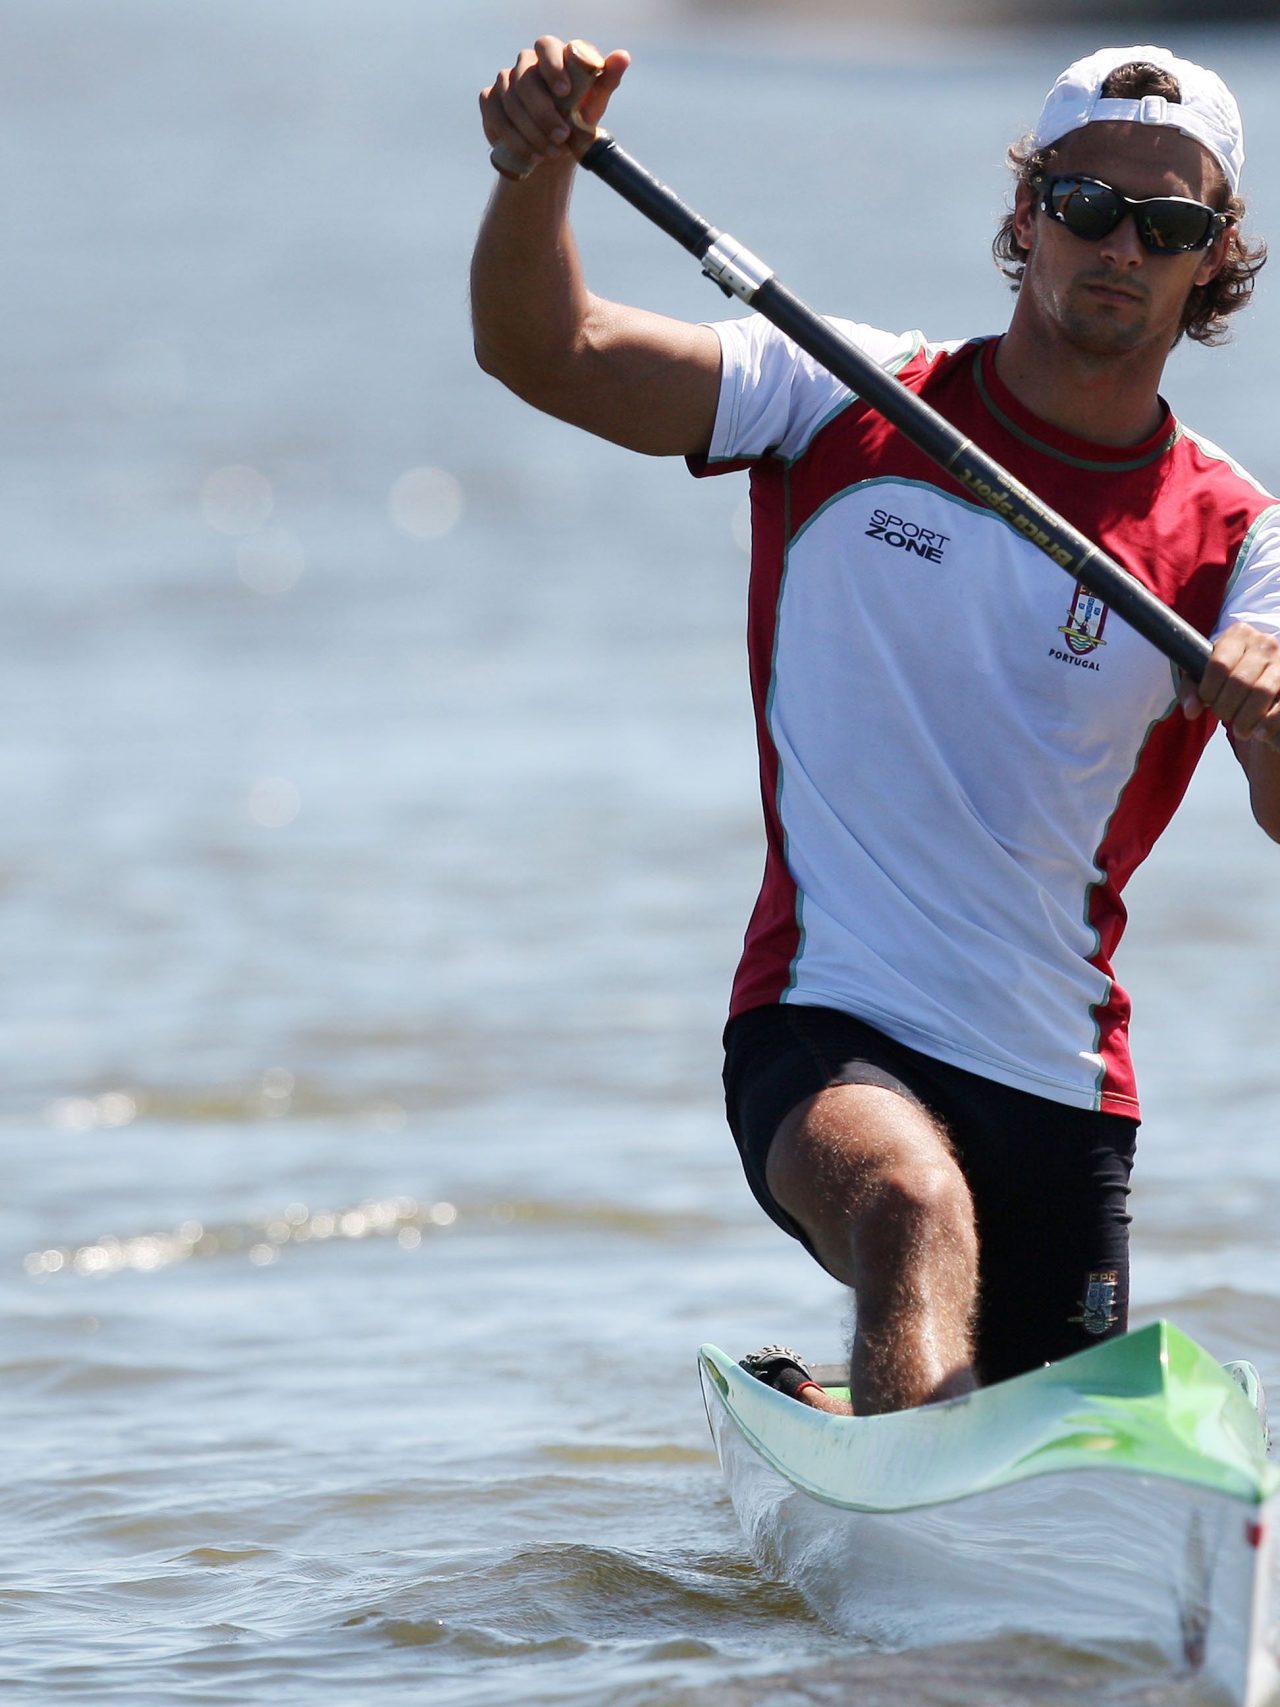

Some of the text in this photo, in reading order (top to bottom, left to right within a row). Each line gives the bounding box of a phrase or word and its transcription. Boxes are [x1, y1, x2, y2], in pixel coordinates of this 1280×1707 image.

[870, 509, 951, 549] SPORT
[959, 468, 1074, 567] Braca-sport
[864, 522, 944, 564] ZONE
[1048, 648, 1101, 672] PORTUGAL
